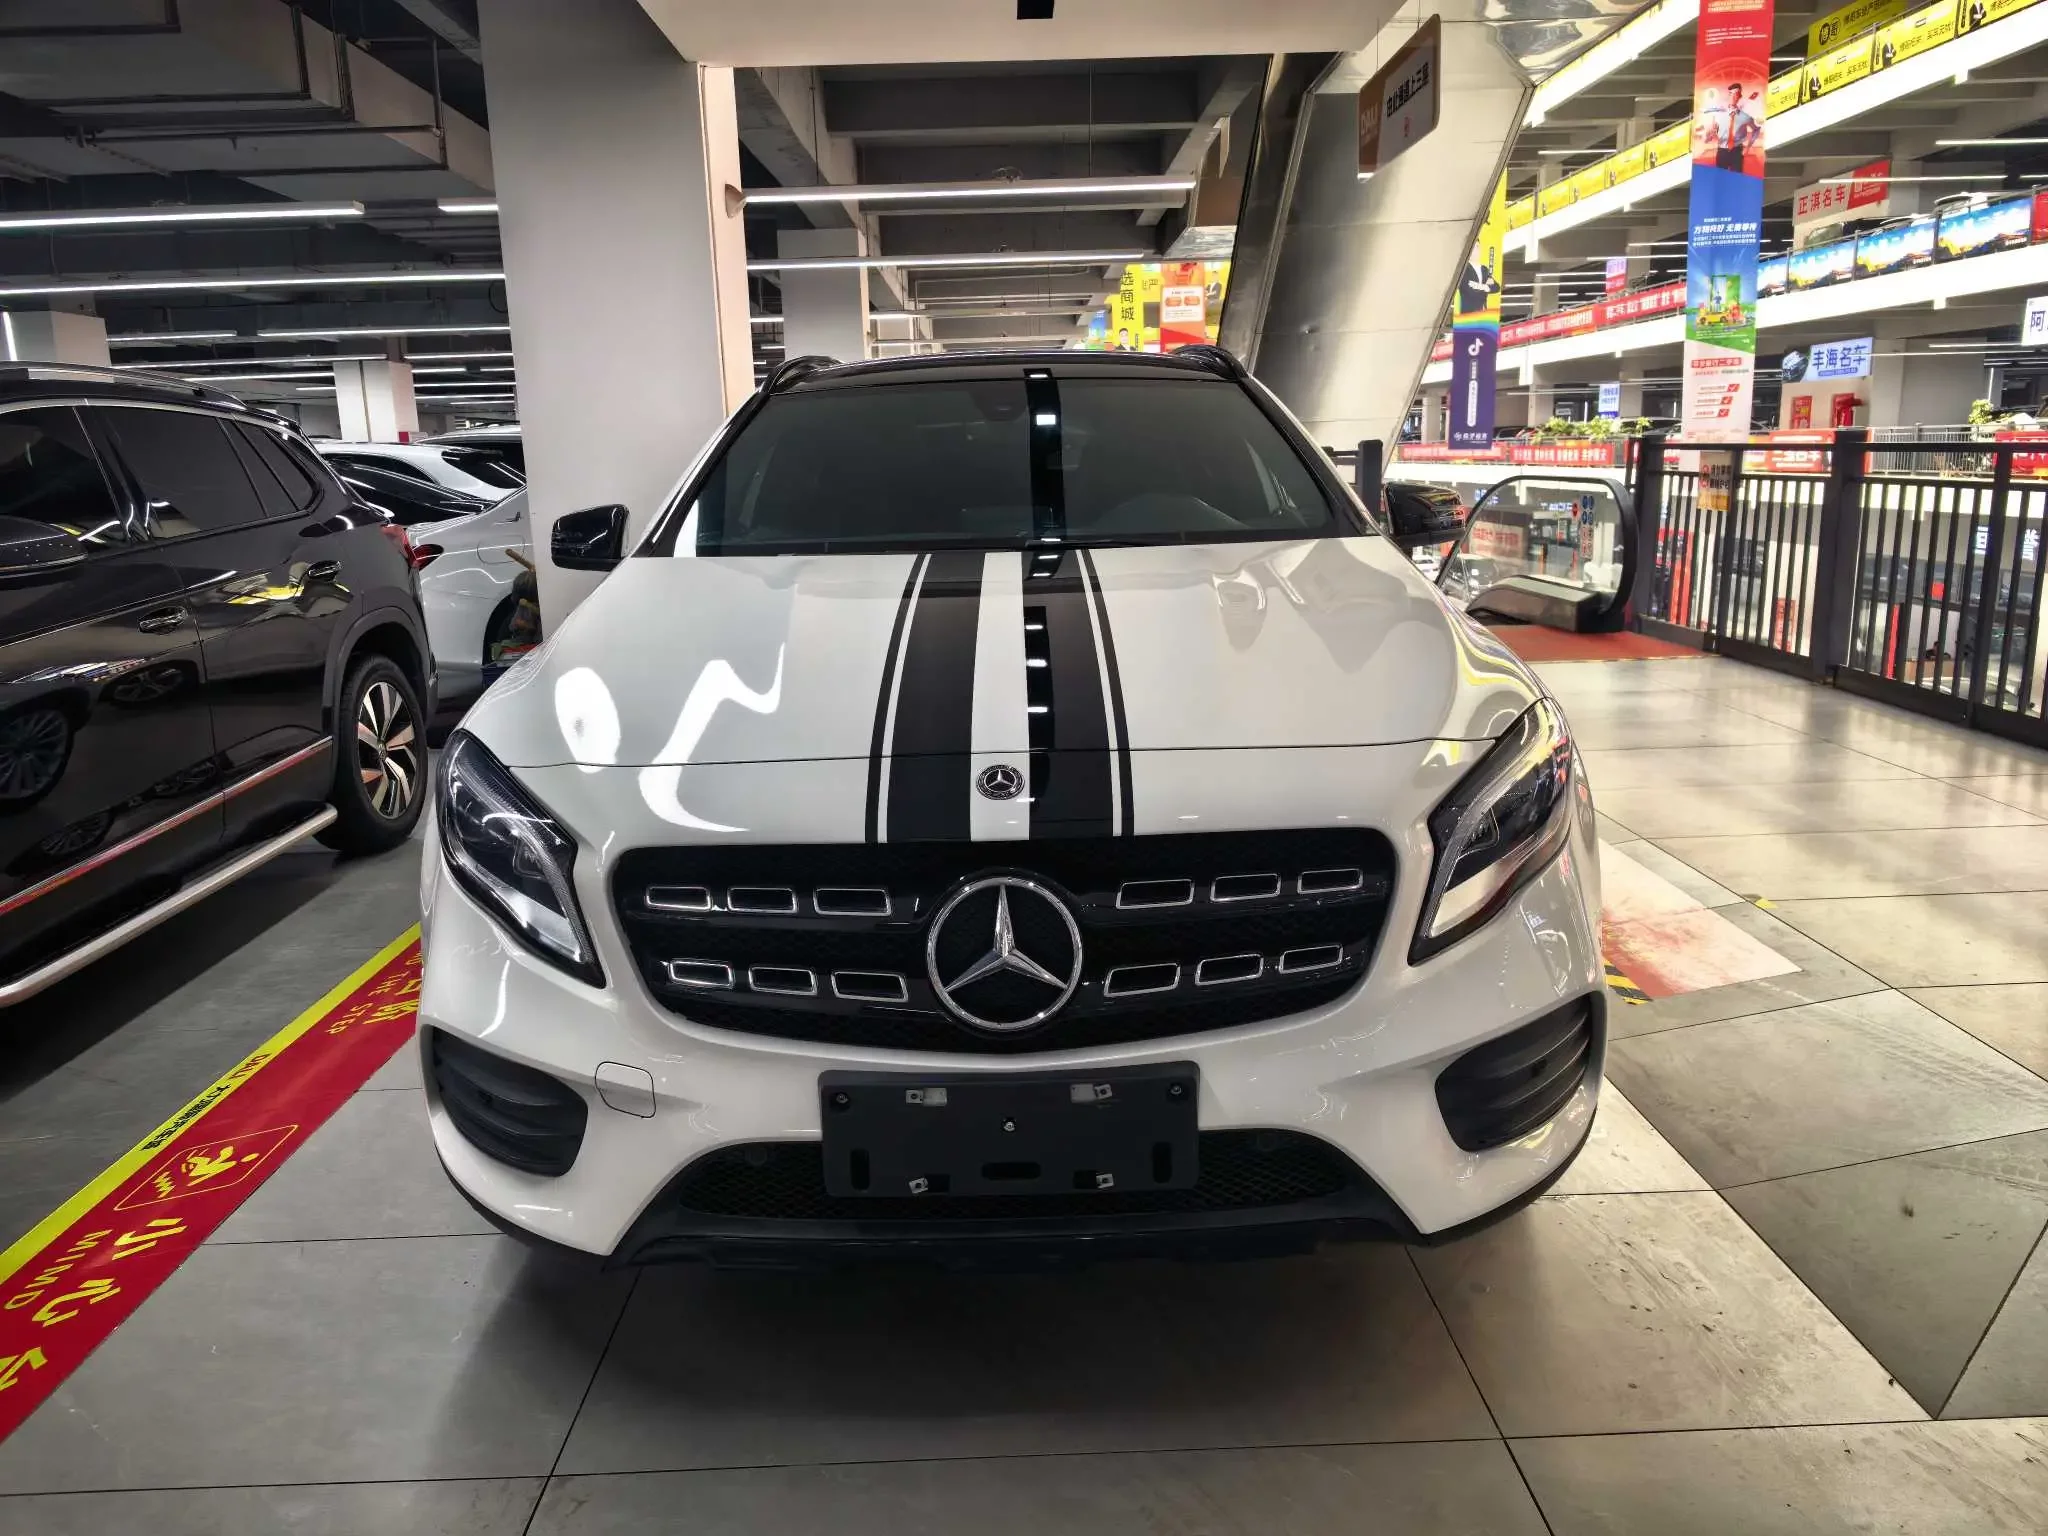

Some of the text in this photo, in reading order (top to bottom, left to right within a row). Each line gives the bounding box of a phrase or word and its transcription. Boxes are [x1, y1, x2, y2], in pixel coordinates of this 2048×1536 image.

[2030, 310, 2048, 333] 阿
[1812, 345, 1868, 370] 丰海名车
[324, 1002, 374, 1034] STEP
[4, 1229, 113, 1310] MIND
